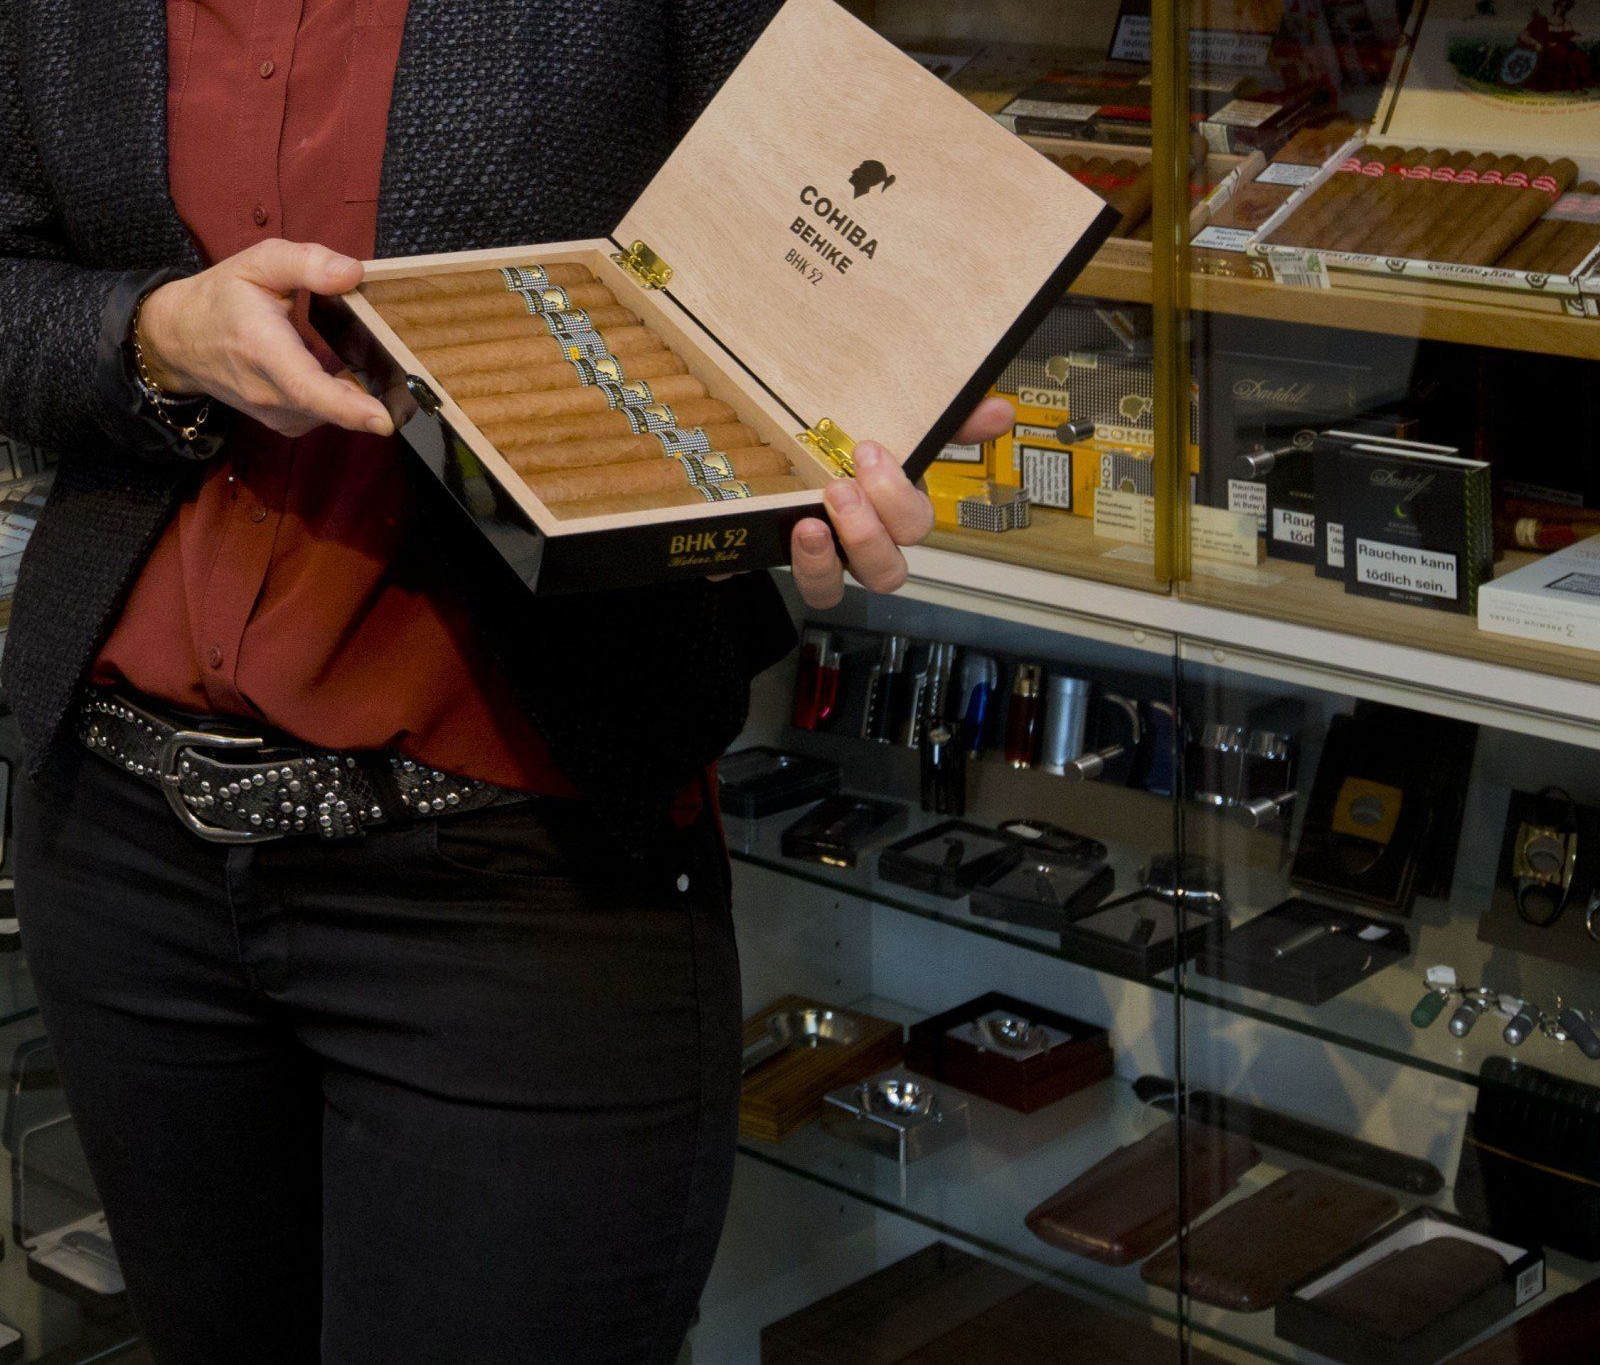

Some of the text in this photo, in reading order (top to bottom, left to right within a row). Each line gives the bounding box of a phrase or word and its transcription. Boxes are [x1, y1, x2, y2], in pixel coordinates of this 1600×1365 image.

[799, 185, 879, 260] COHIBA
[789, 216, 854, 275] BEHIKE
[784, 248, 824, 287] BHK 52
[1020, 390, 1067, 407] COH
[1232, 482, 1265, 494] Rauchen
[1233, 492, 1247, 500] und
[669, 527, 748, 555] BHK 52
[1358, 543, 1455, 573] Rauchen kann
[1366, 567, 1448, 594] tödlich sein.
[1523, 620, 1562, 632] PREMIUM
[1565, 623, 1575, 638] 3
